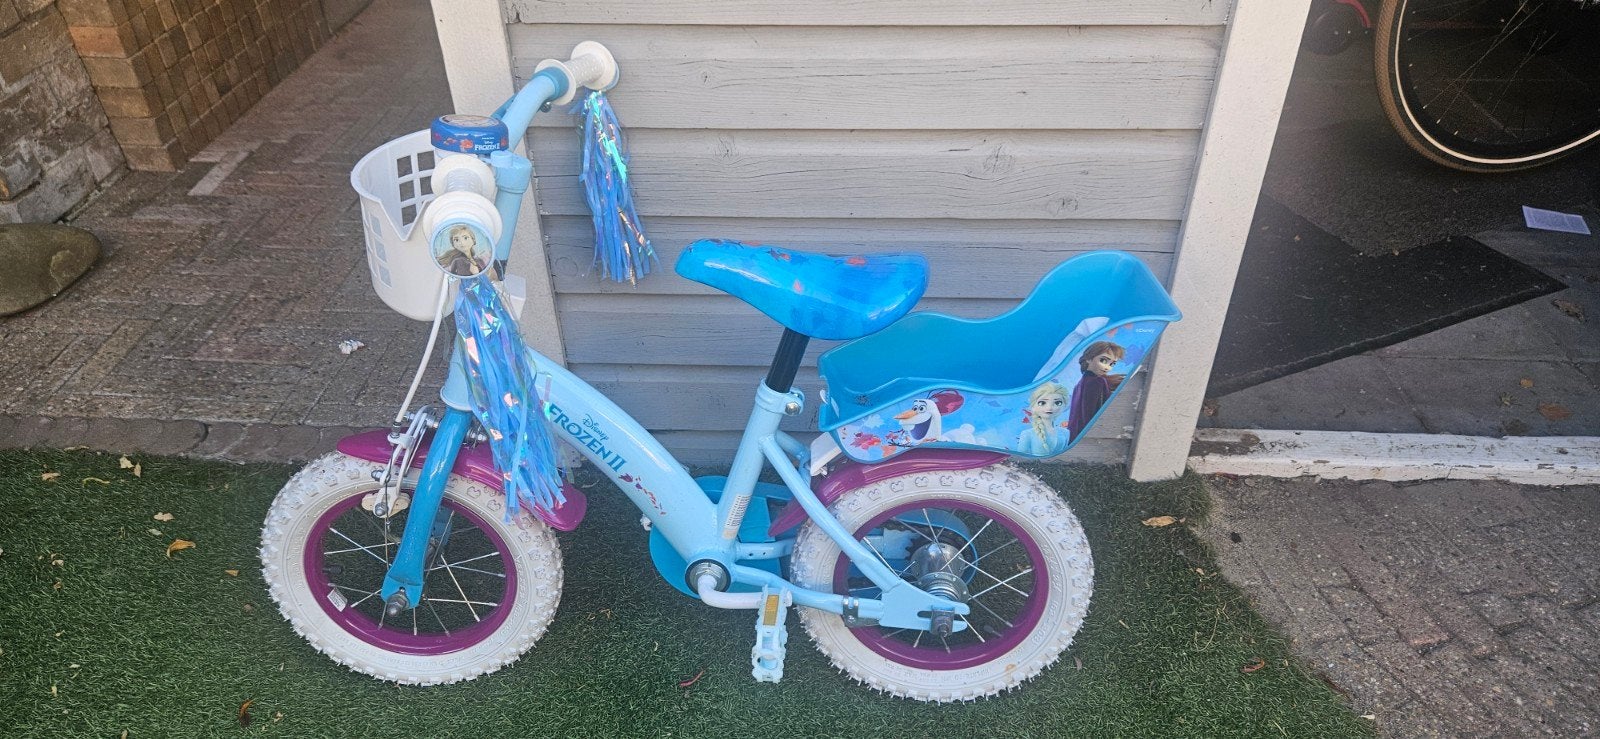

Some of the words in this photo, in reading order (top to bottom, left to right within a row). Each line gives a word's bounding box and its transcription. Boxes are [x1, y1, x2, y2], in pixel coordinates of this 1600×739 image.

[548, 403, 613, 461] FROZEN
[607, 454, 628, 473] II
[582, 413, 609, 441] Disney
